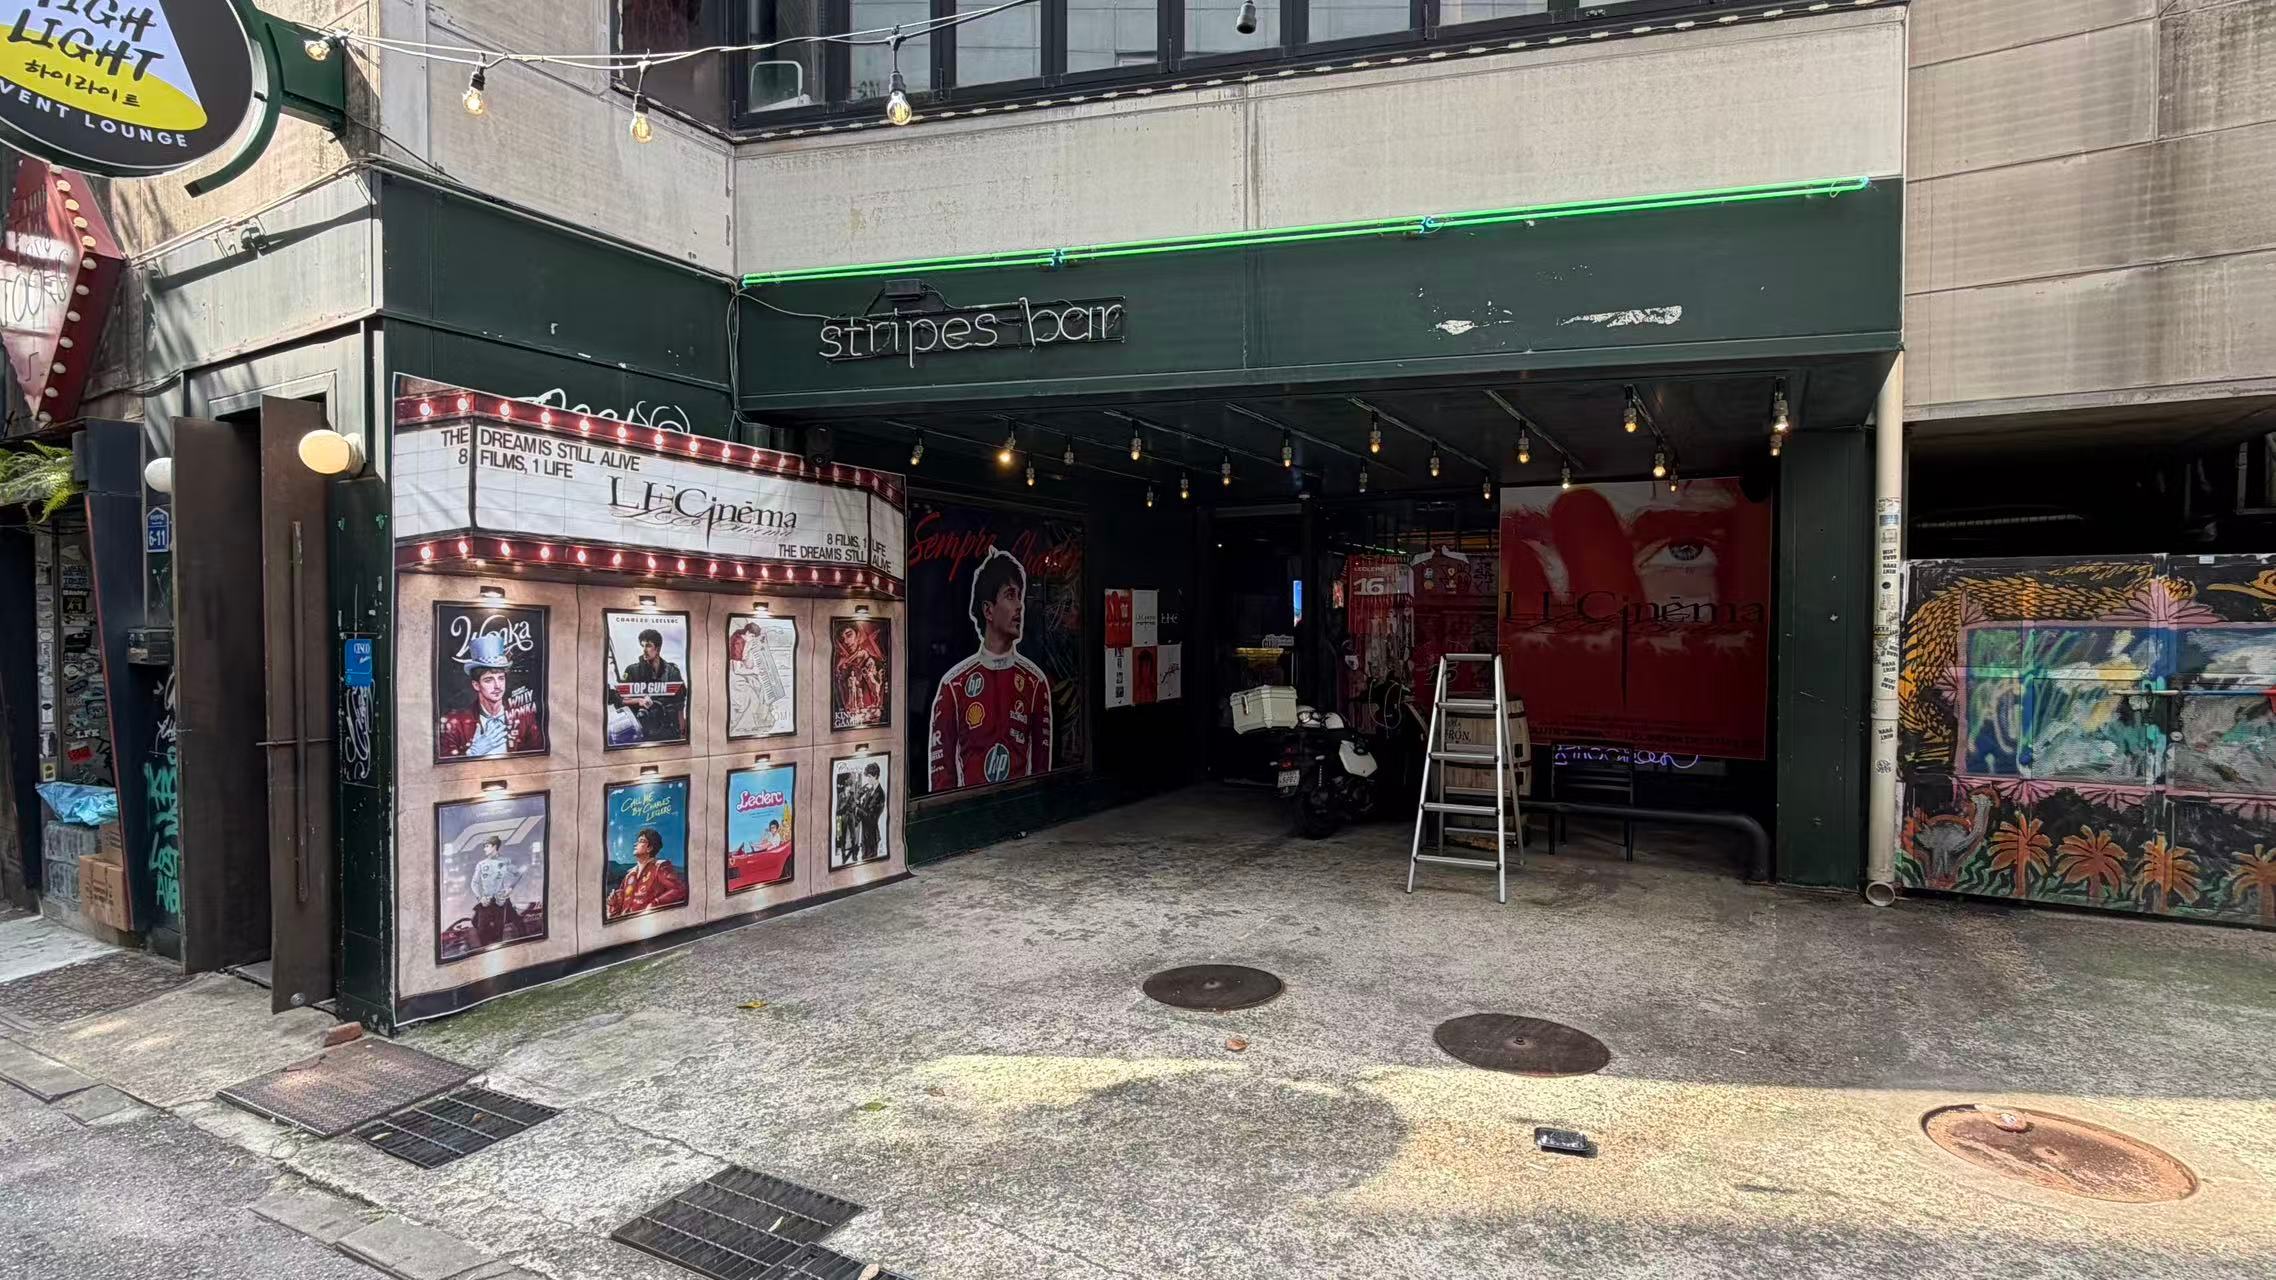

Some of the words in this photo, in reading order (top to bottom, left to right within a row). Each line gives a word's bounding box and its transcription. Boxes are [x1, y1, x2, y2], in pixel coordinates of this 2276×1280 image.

[38, 0, 157, 42] IGH
[8, 8, 165, 82] LIGHT
[25, 59, 140, 108] 하이라이트
[84, 114, 188, 148] LOUNGE
[818, 305, 999, 369] stripes
[1018, 296, 1126, 347] bar
[440, 426, 470, 448] THE
[557, 443, 595, 464] STILL
[599, 450, 641, 472] ALIVE
[458, 448, 468, 465] 8
[480, 450, 528, 475] FILMS,
[532, 458, 539, 474] 1
[544, 461, 574, 479] LIFE
[149, 530, 166, 546] 6-11
[826, 534, 834, 546] 8
[835, 534, 860, 549] FILMS,
[872, 538, 887, 558] LIFE
[778, 544, 797, 558] THE
[844, 550, 867, 563] STILL
[871, 556, 893, 574] ALIVE
[1353, 577, 1385, 596] 16
[507, 689, 533, 709] WILLY
[629, 681, 646, 694] TOP
[647, 681, 667, 694] GUN
[736, 790, 783, 811] Leclerc
